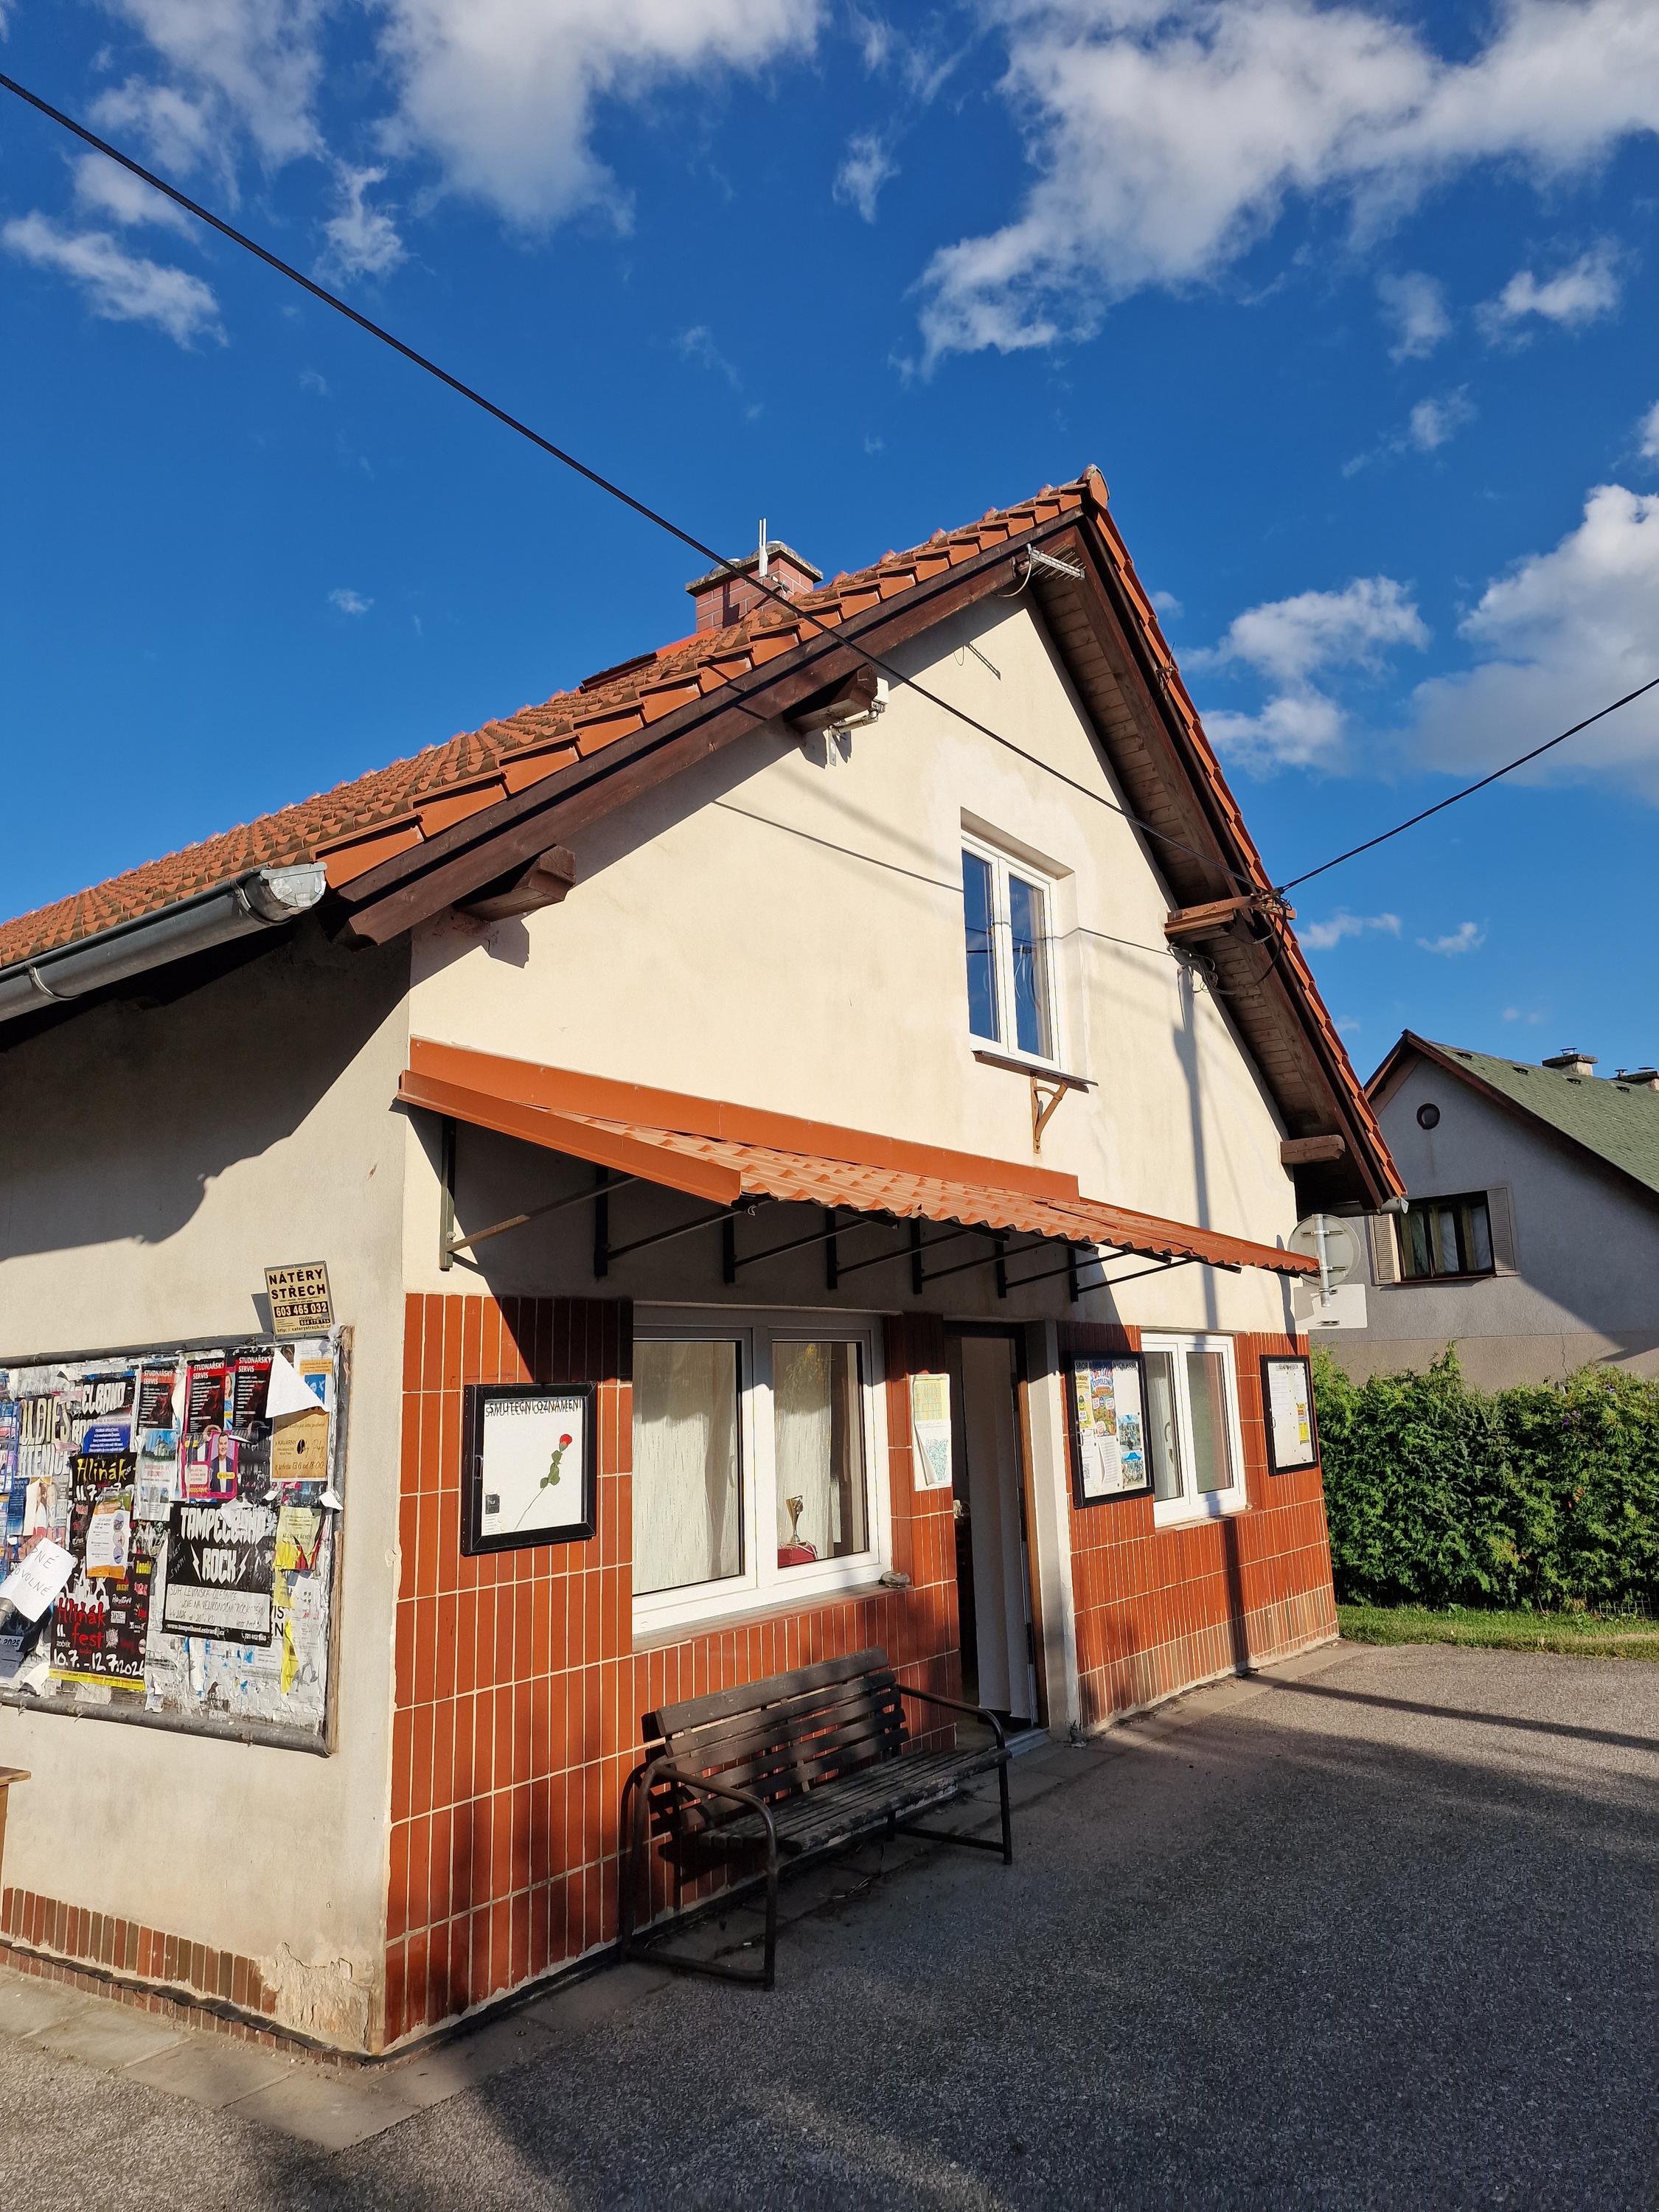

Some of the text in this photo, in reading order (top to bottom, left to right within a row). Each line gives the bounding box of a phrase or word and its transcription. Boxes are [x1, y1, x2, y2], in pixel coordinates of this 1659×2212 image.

[268, 1269, 323, 1285] NÁTĚRY
[271, 1284, 326, 1299] STŘECH
[276, 1302, 327, 1317] 603 465 032
[193, 1361, 225, 1371] STUDNAŘSKÝ
[238, 1354, 271, 1364] STUDNAŘSKÝ
[192, 1371, 209, 1380] SERVIS
[201, 1547, 237, 1584] ROCK
[72, 1622, 105, 1649] fest
